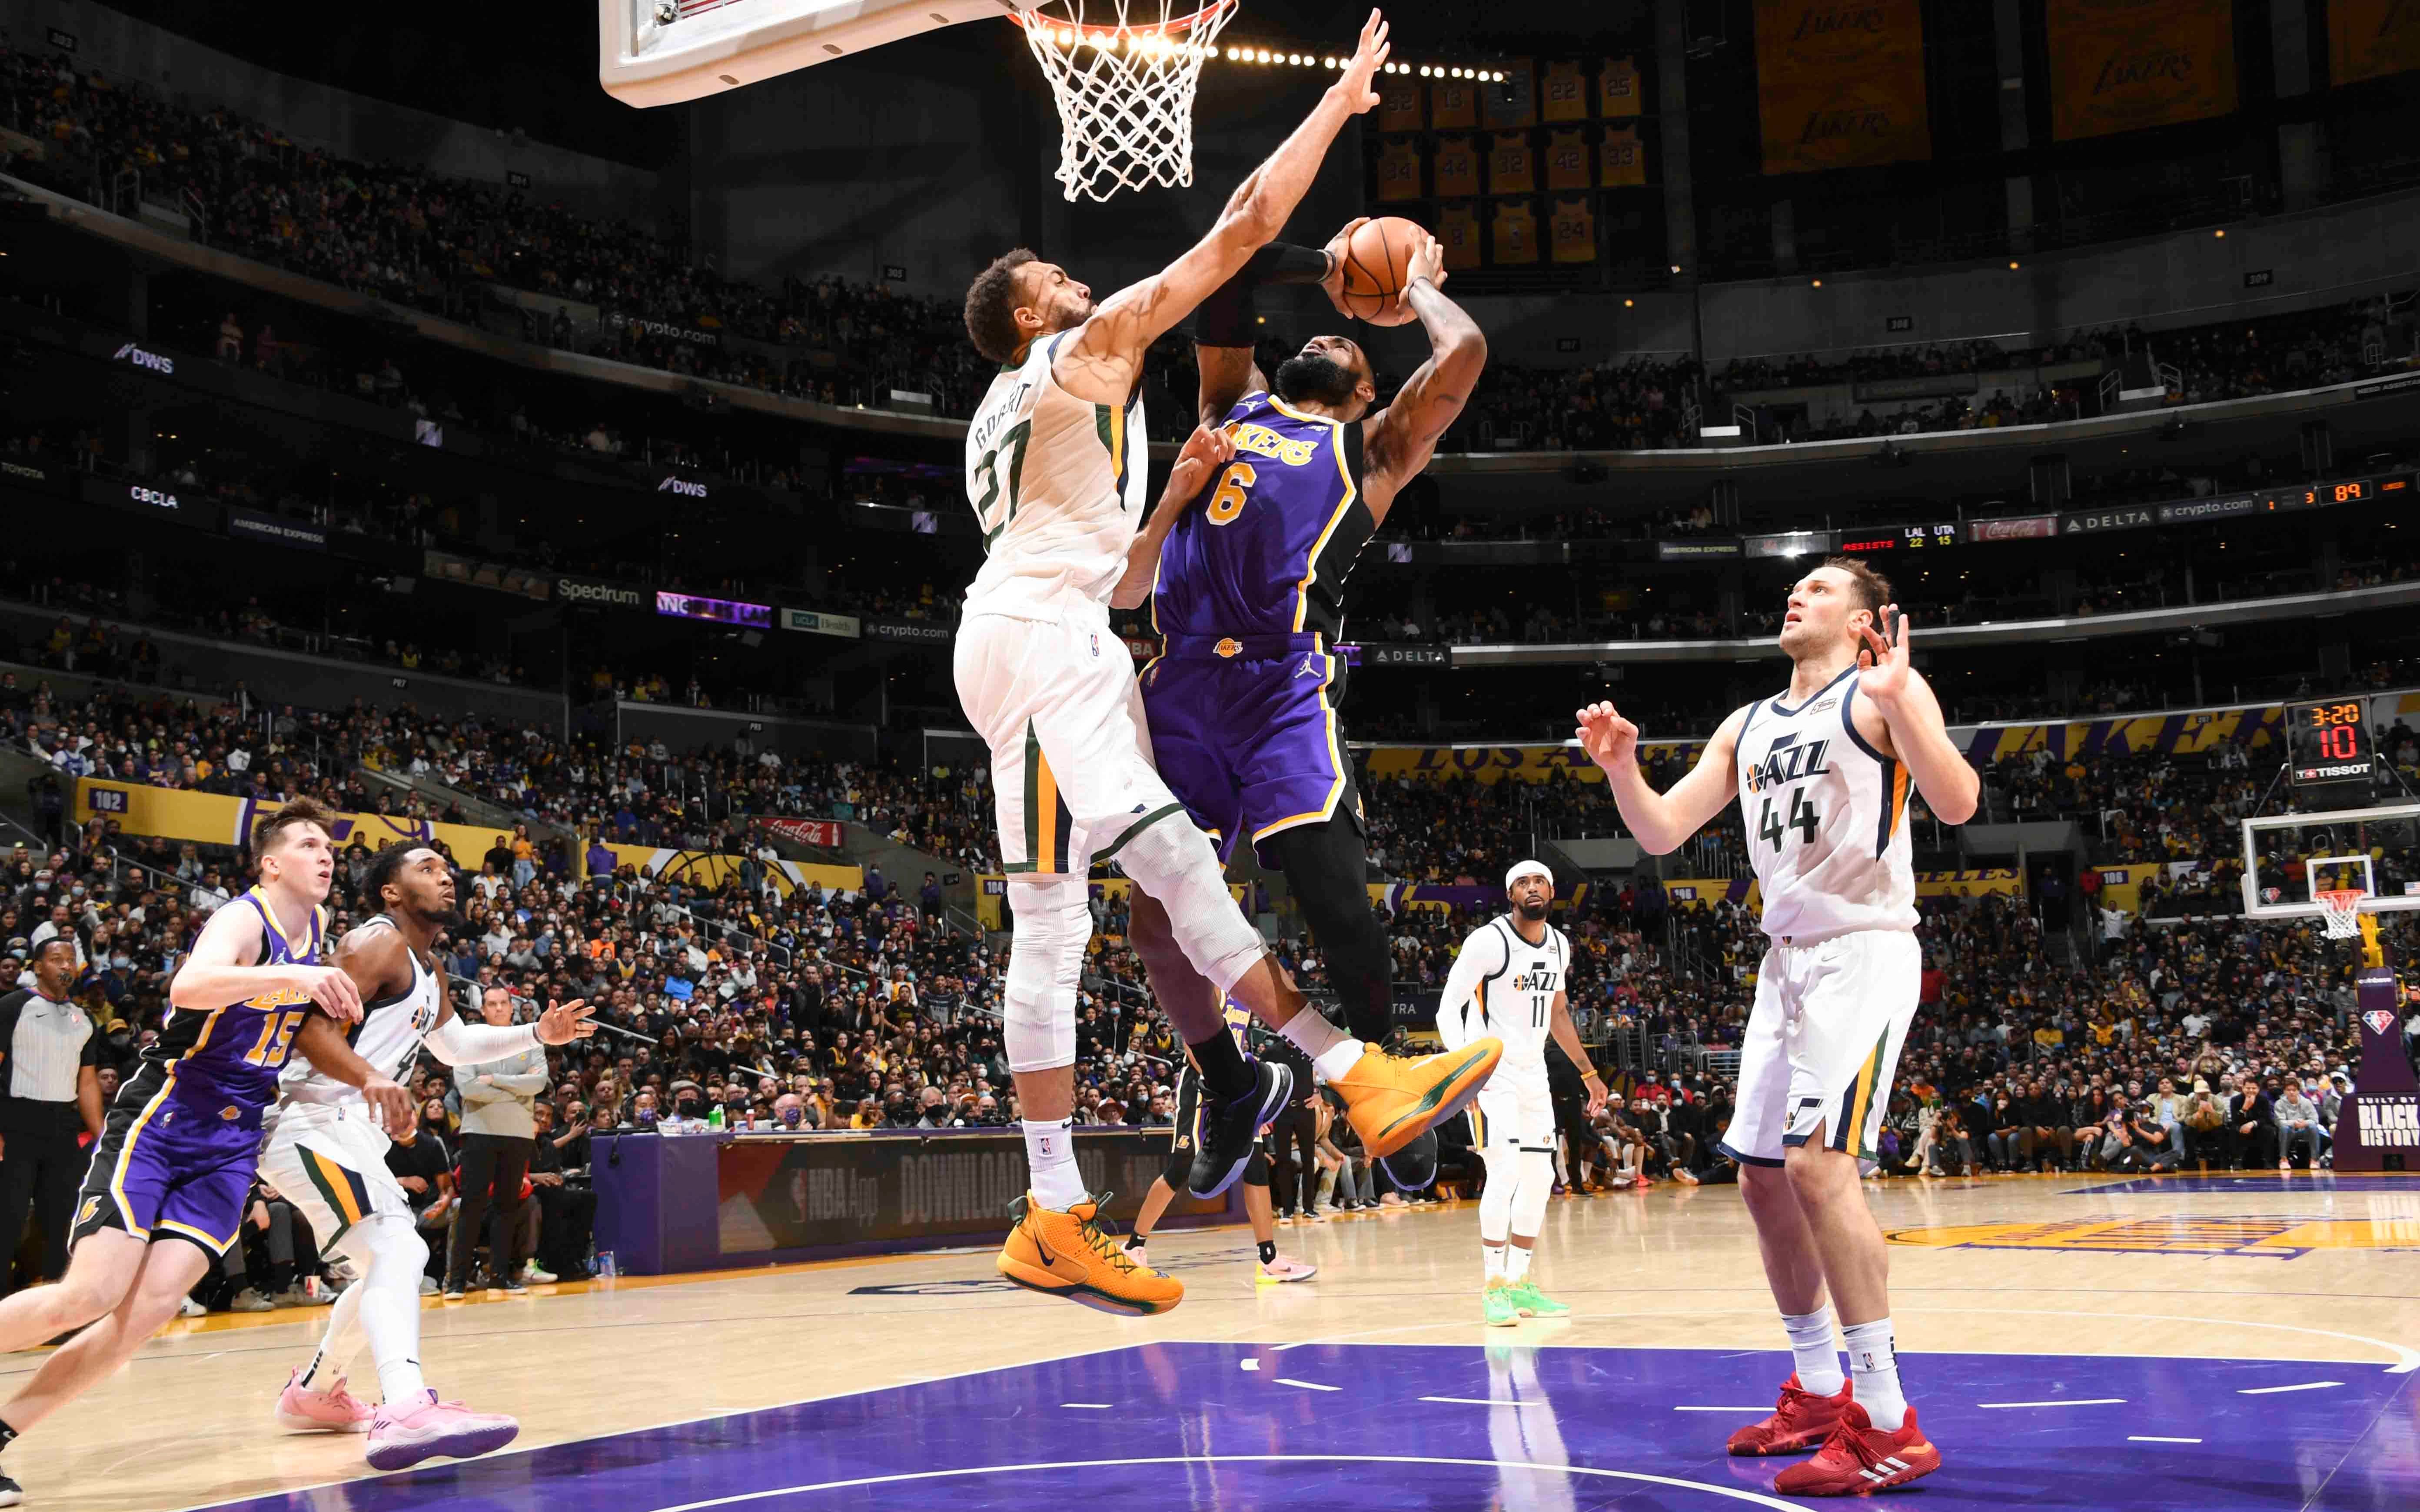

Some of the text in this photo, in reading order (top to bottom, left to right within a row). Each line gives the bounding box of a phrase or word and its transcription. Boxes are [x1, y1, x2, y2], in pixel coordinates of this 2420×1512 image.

[1550, 82, 1576, 101] 22
[1606, 78, 1632, 97] 25
[1608, 149, 1633, 166] 33
[132, 348, 174, 375] DWS
[673, 480, 708, 497] DWS
[974, 419, 1031, 555] 27
[1205, 462, 1257, 526] 6
[2334, 483, 2362, 502] 89
[2175, 498, 2253, 516] crypto.com
[2086, 512, 2149, 529] DELTA
[233, 519, 325, 544] AMERICAN EXPRESS
[1904, 525, 1955, 538] LAL UTA
[1843, 535, 1951, 551] ASSISTS 22 15
[559, 578, 640, 605] Spectrum
[879, 625, 949, 639] crypto.com
[1393, 650, 1446, 663] DELTA
[2310, 703, 2360, 726] 3:20
[2319, 725, 2357, 759] 10
[2316, 763, 2371, 777] TISSOT
[95, 790, 122, 811] 102
[1760, 786, 1821, 853] 44
[987, 881, 1004, 894] 104
[2103, 872, 2123, 884] 106
[1532, 995, 1545, 1028] 11
[243, 1011, 306, 1068] 15
[2358, 1104, 2420, 1129] BLACK
[2360, 1129, 2420, 1146] HISTORY
[808, 1168, 846, 1221] NBA
